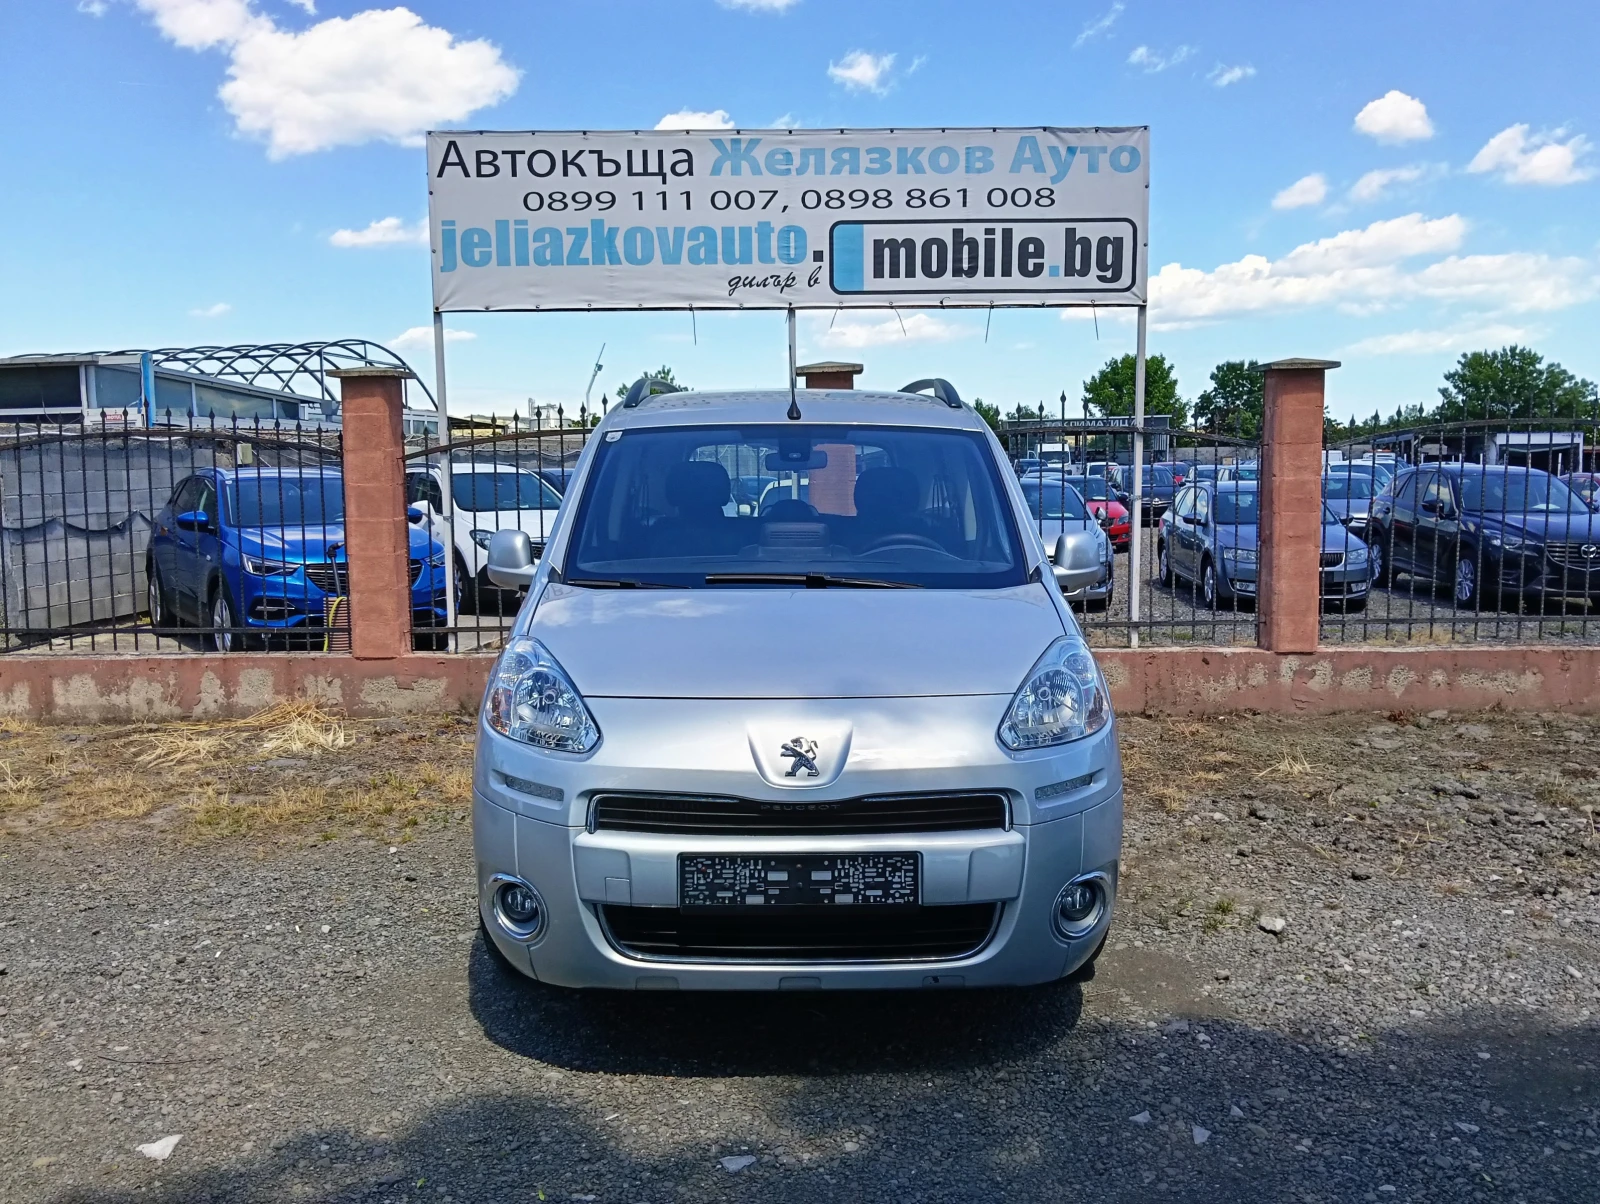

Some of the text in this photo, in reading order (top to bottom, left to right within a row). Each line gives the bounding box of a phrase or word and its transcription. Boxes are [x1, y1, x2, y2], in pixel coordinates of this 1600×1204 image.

[437, 135, 1142, 185] Автокъща Желязков Ауто
[522, 187, 1057, 213] 0899 111 007, 0898 861 008
[873, 227, 1124, 283] mobile.bg
[728, 265, 821, 296] дилър в
